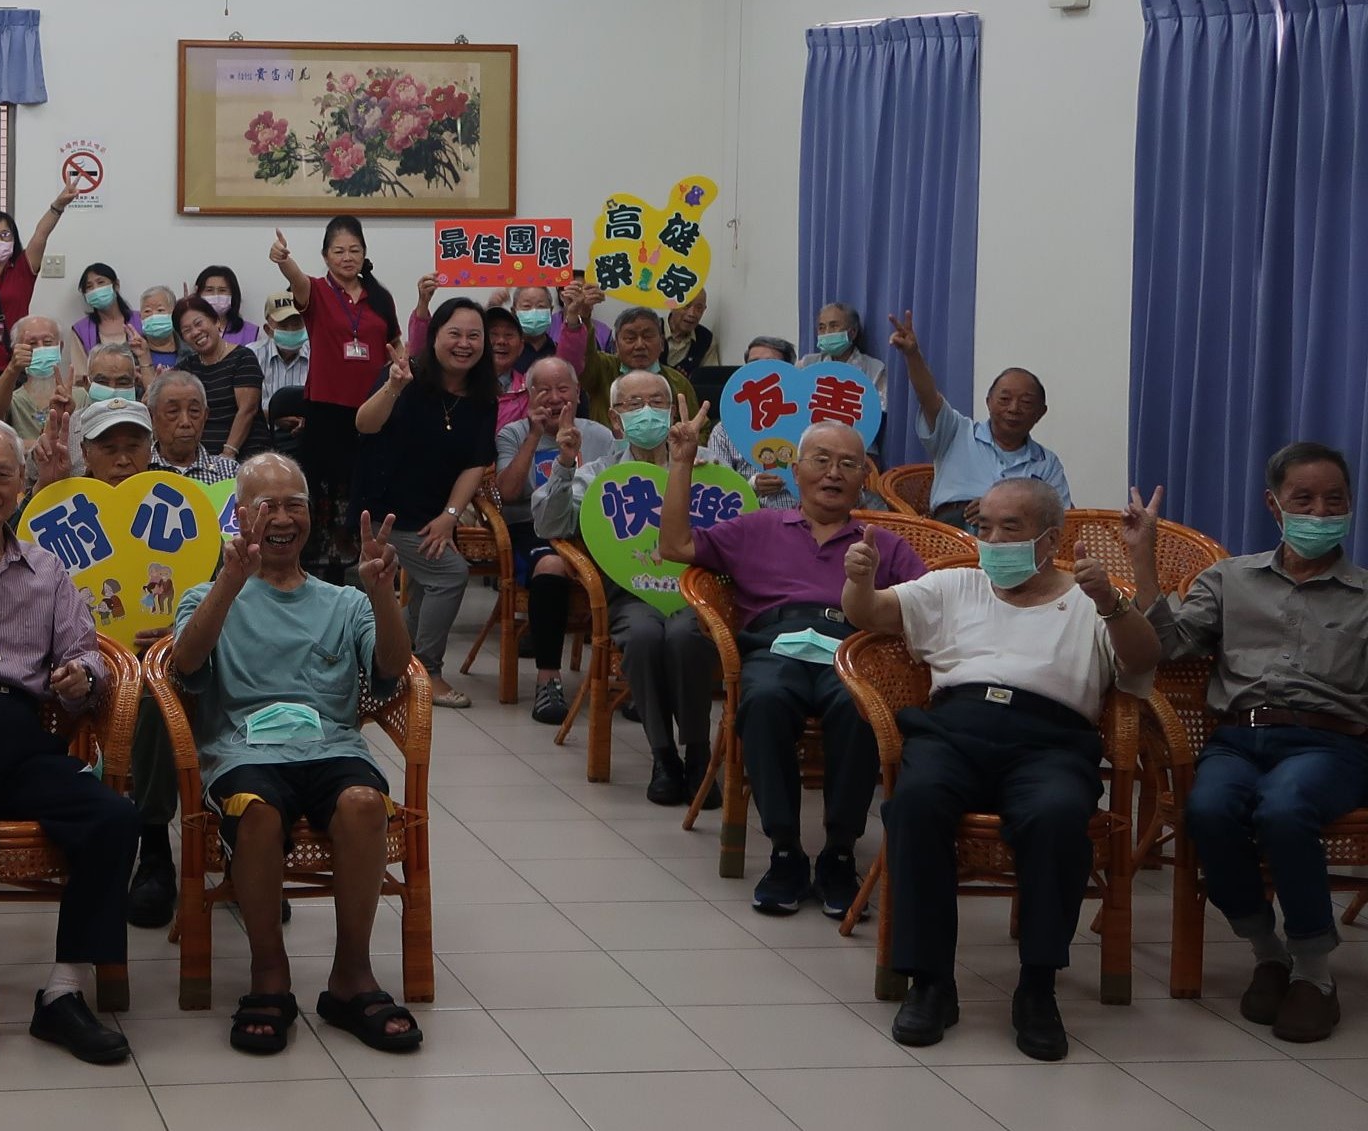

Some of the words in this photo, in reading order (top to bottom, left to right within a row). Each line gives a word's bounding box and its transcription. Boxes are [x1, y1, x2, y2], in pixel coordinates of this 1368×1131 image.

[438, 224, 571, 268] 最佳團隊
[605, 203, 700, 257] 高雄
[733, 372, 866, 432] 友善
[29, 482, 198, 572] 耐心
